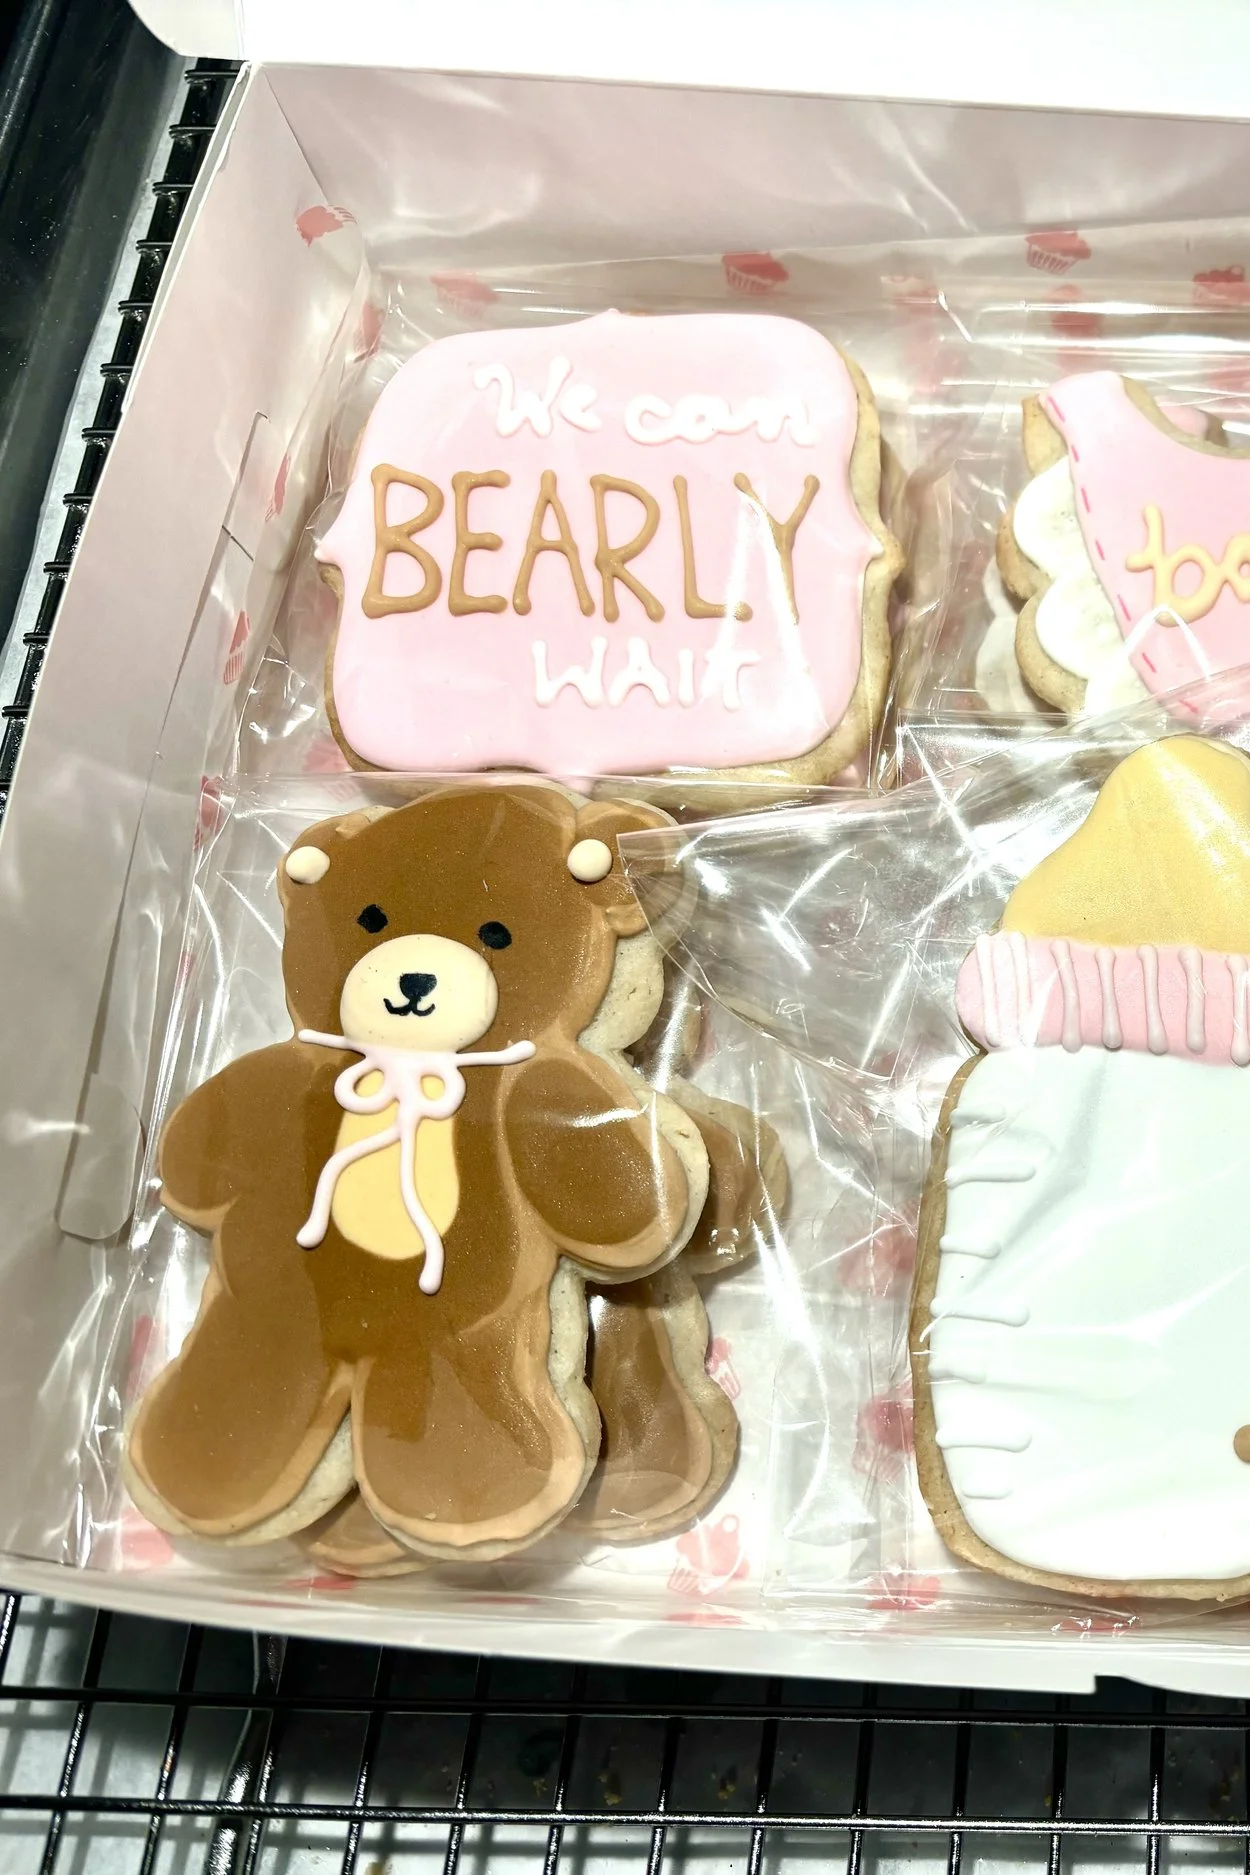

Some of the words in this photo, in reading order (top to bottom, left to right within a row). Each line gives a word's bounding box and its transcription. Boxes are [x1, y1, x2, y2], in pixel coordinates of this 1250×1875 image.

[473, 356, 601, 438] We
[623, 395, 820, 447] can
[361, 463, 821, 624] BEARLY
